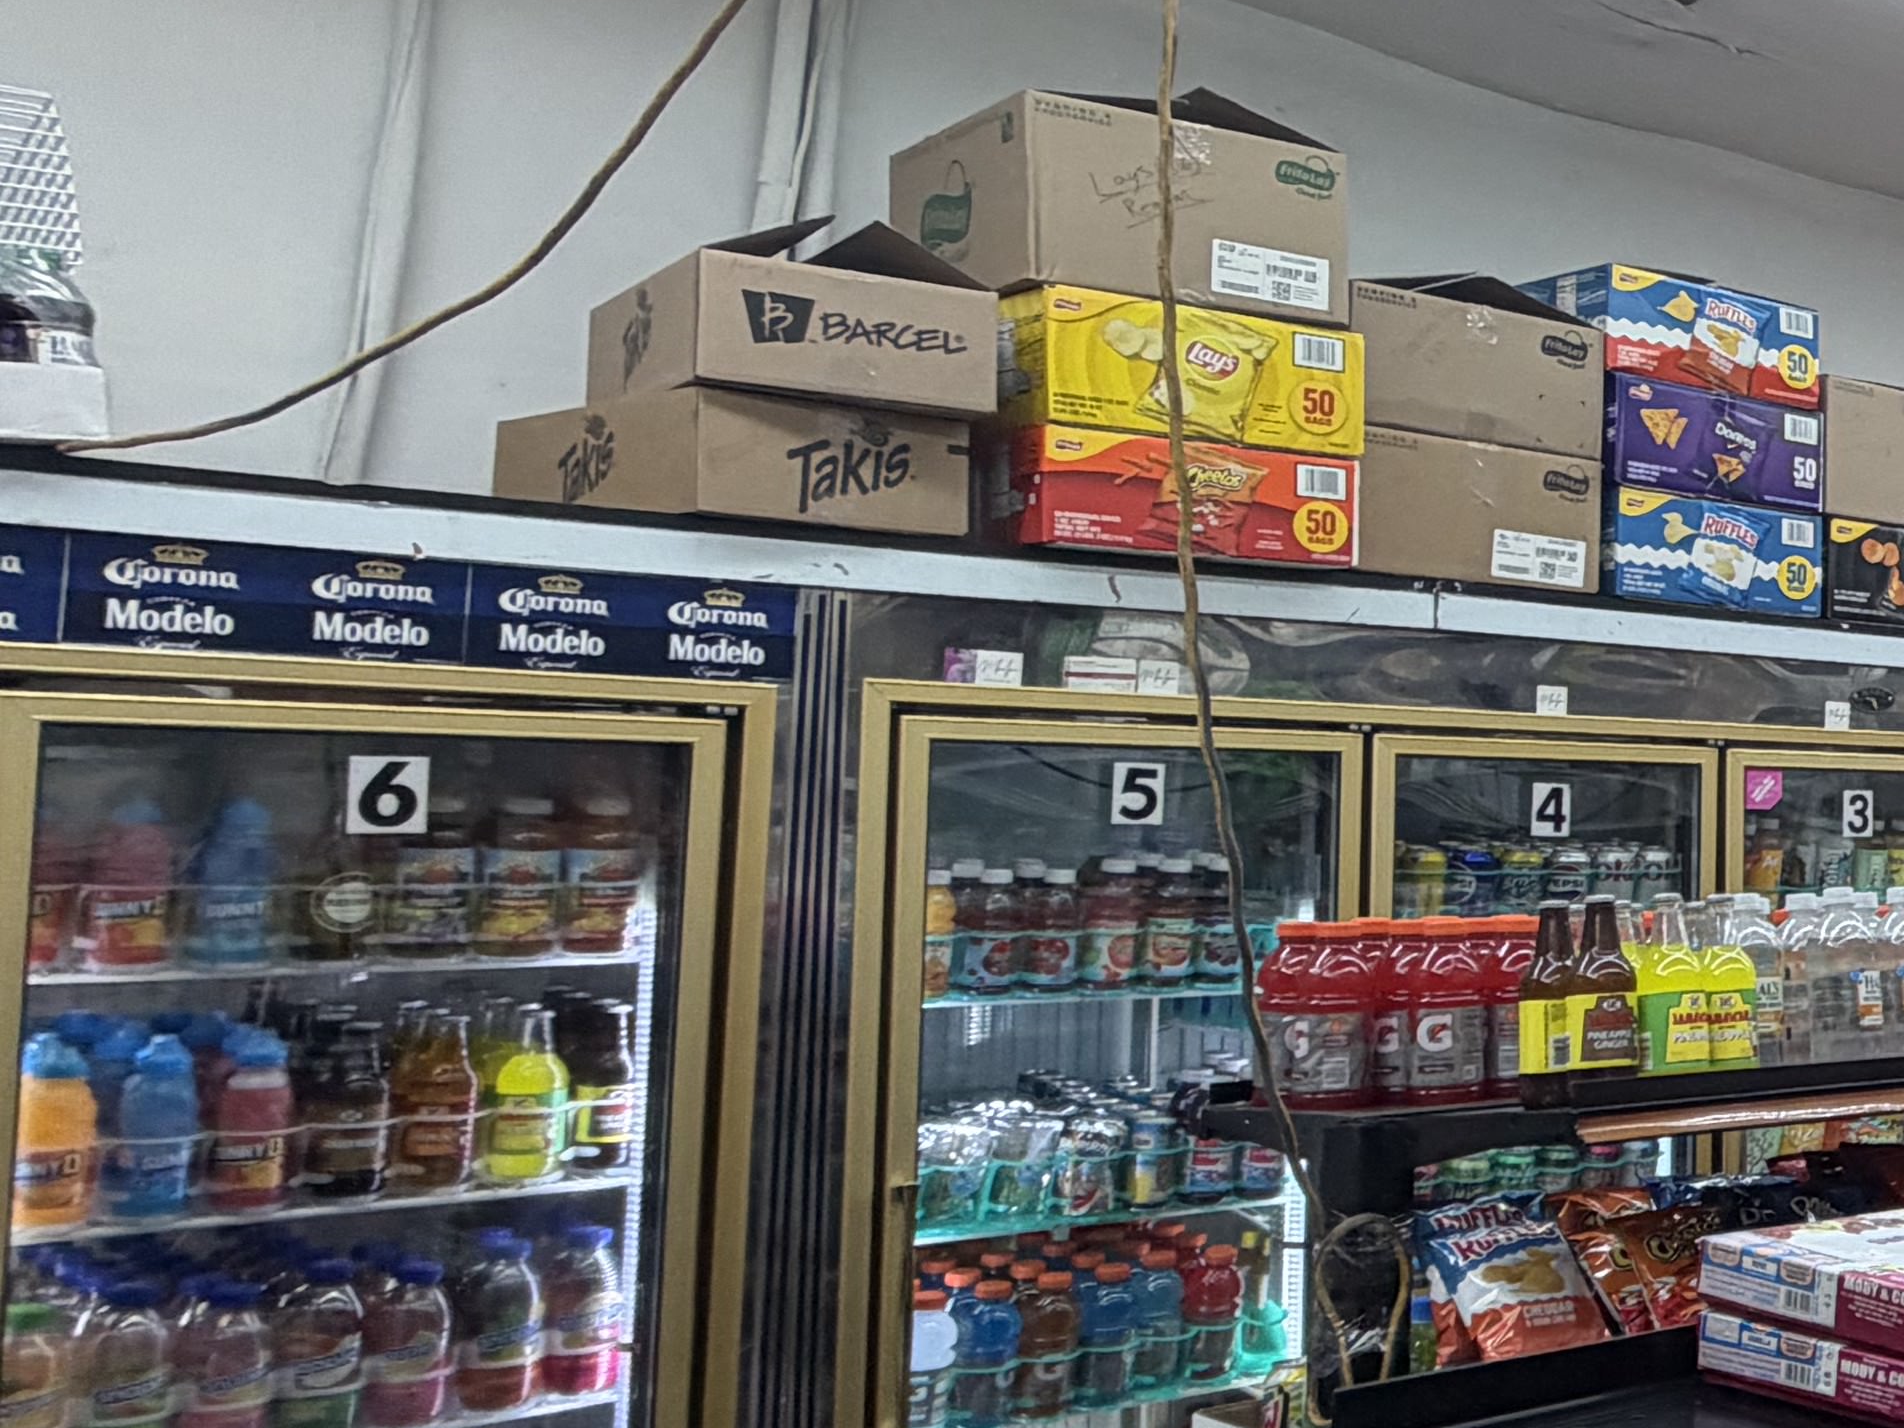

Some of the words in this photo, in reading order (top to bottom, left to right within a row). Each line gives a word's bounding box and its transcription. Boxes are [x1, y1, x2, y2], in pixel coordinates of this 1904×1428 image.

[1706, 299, 1757, 332] RUFFLES
[820, 313, 966, 355] BARCEL
[1187, 340, 1240, 376] Lay's
[1786, 352, 1809, 375] 50
[1302, 388, 1336, 418] 50
[1715, 420, 1758, 453] Doritos
[556, 431, 615, 504] Takis
[788, 442, 911, 514] Takis
[1186, 465, 1244, 491] Cheetos
[1793, 456, 1817, 482] 50
[1305, 509, 1337, 539] 50
[1704, 514, 1758, 550] RUFFLES
[103, 557, 240, 591] Corona
[311, 573, 435, 605] Corona
[1786, 567, 1808, 587] 50
[103, 597, 235, 636] Modelo
[498, 585, 609, 620] Corona
[667, 600, 769, 630] Corona
[312, 610, 430, 647] Modelo
[498, 624, 606, 659] Modelo
[668, 634, 766, 668] Modelo
[357, 762, 419, 829] 6
[1119, 768, 1159, 820] 5
[1536, 785, 1567, 833] 4
[1847, 794, 1870, 834] 3
[1417, 1013, 1453, 1052] G
[1523, 1300, 1575, 1317] CHEDDAR
